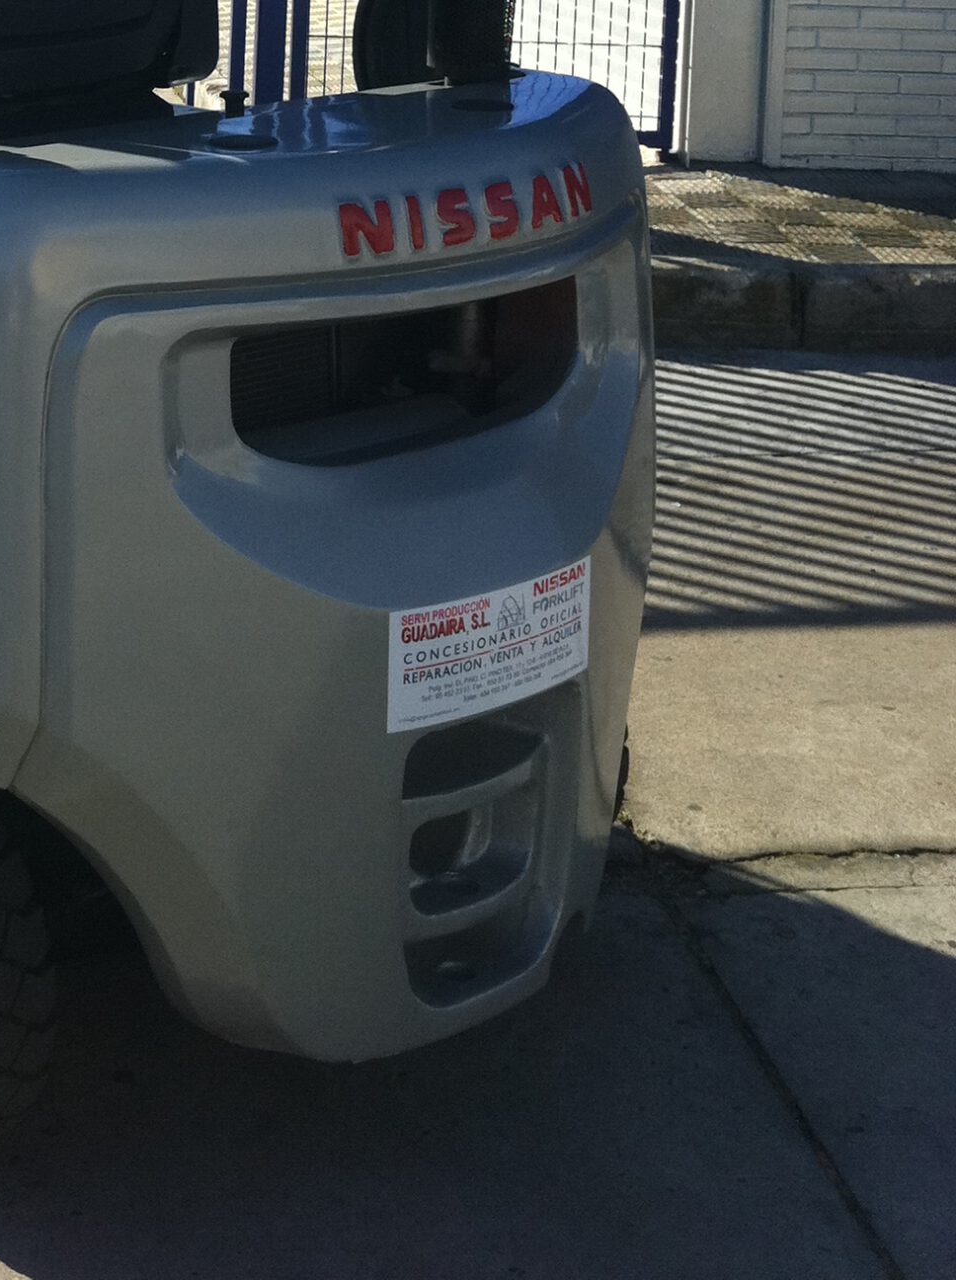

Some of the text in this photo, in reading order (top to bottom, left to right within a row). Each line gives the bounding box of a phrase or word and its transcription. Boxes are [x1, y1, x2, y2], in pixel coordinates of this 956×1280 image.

[338, 161, 593, 257] NISSAN
[532, 562, 586, 597] NISSAN
[532, 582, 585, 615] FORKLIFT
[401, 596, 491, 627] SERVI PRODUCCIÓN
[403, 602, 583, 665] CONCESIONARIO OFICIAL
[490, 644, 524, 665] VENTA
[530, 640, 537, 652] Y
[542, 620, 582, 647] ALQUILER
